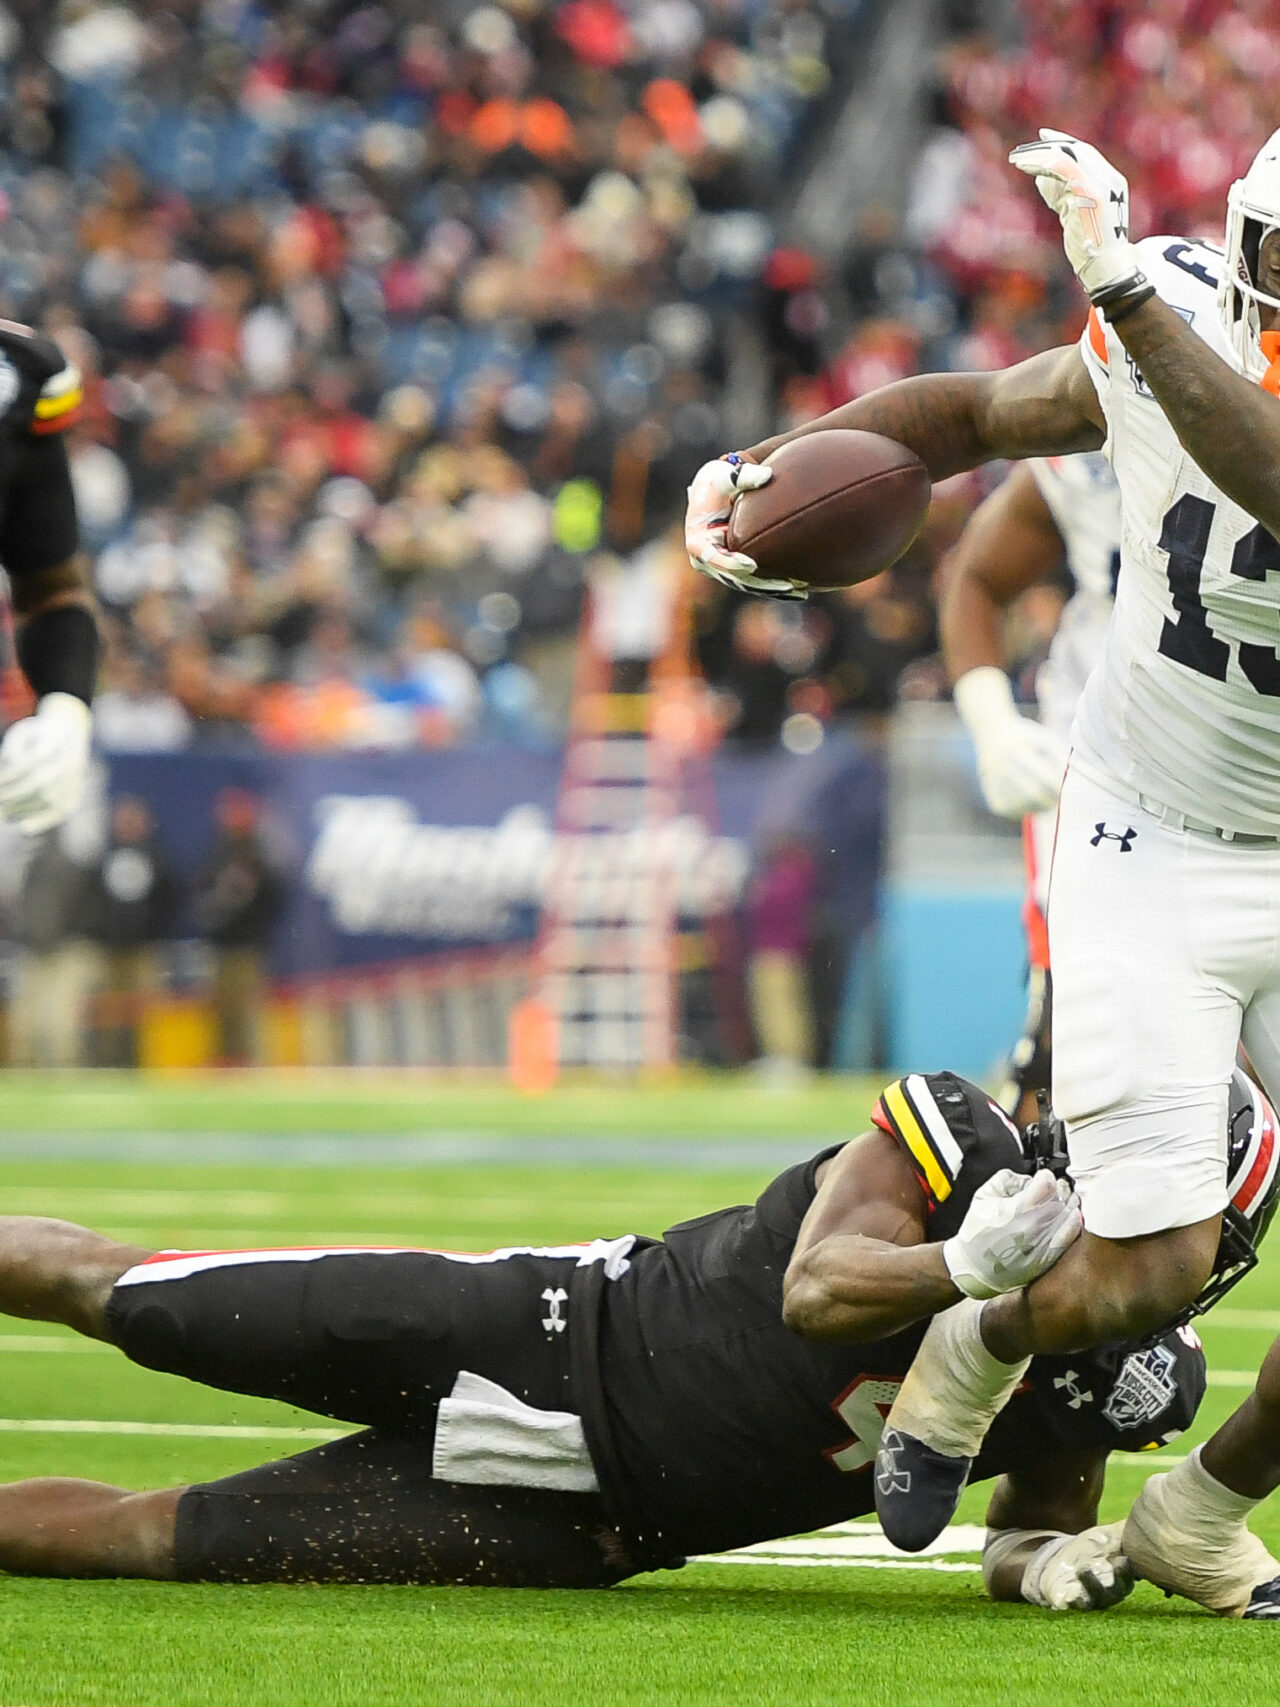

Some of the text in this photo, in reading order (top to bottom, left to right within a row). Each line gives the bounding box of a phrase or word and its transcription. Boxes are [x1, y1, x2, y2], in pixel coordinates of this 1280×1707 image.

[1120, 1369, 1164, 1416] MUSIC CITY
[1121, 1388, 1144, 1416] BOWL
